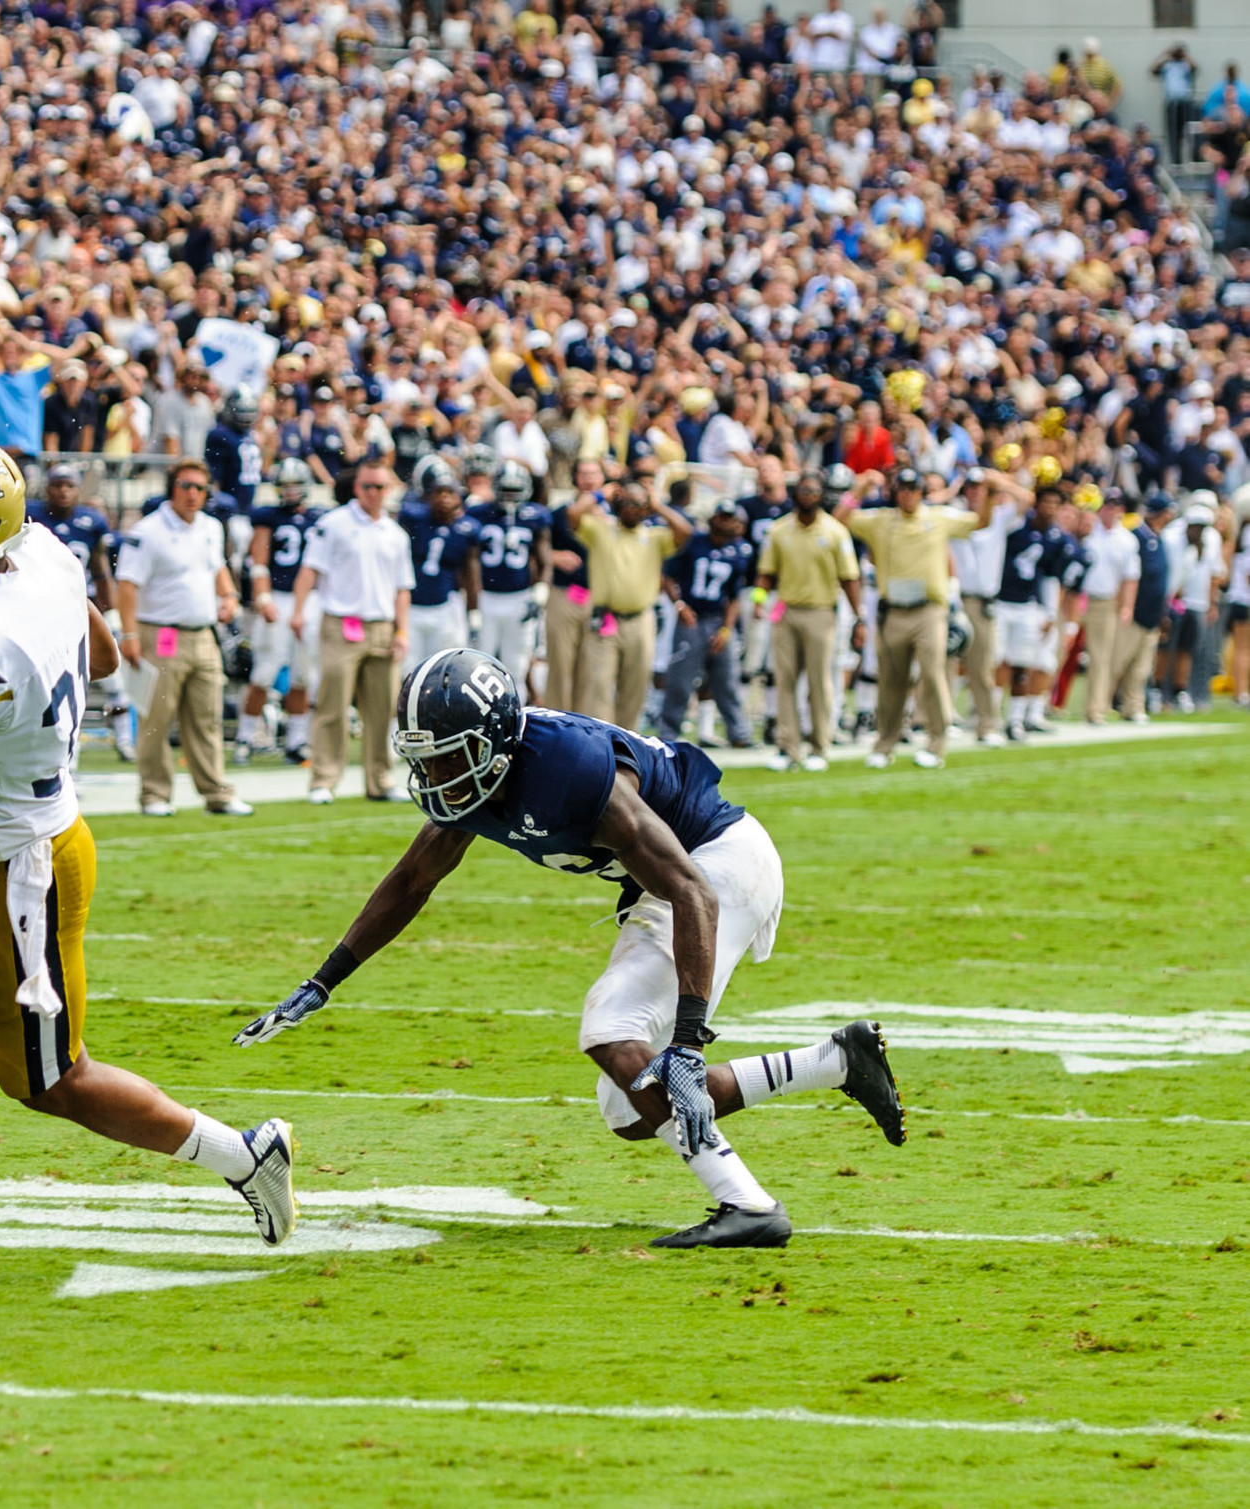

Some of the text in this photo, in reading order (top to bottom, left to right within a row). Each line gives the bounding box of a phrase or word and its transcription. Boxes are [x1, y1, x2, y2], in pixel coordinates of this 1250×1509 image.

[421, 537, 446, 577] 1
[479, 524, 533, 570] 35
[690, 556, 733, 601] 17
[460, 665, 505, 716] 16
[250, 1121, 279, 1160] NIKE
